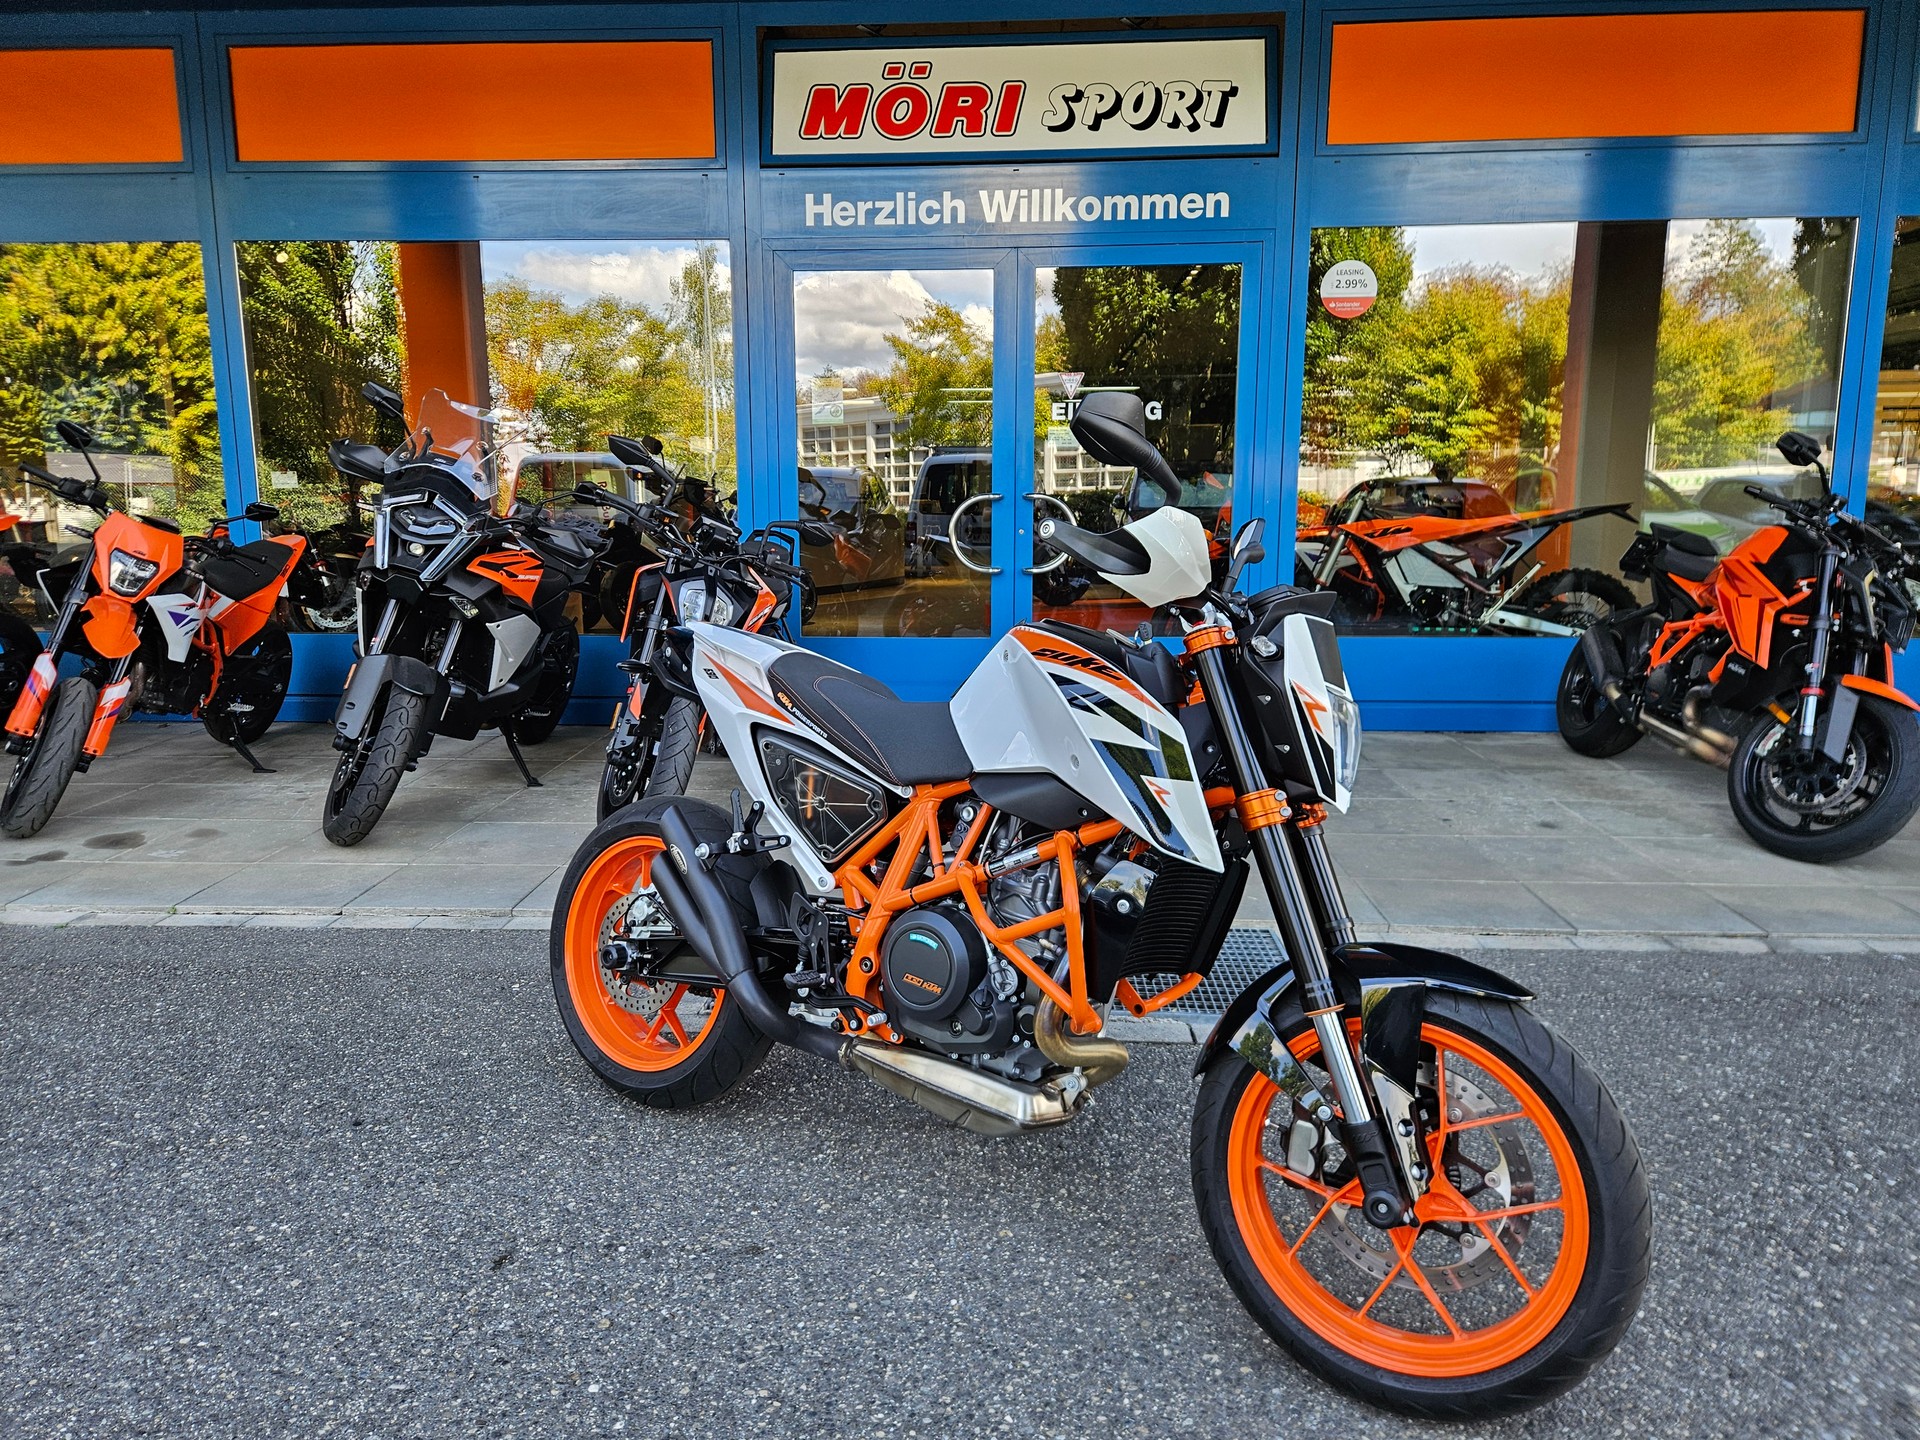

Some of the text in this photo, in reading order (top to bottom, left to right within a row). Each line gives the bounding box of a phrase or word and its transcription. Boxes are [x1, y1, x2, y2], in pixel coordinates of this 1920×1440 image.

[800, 61, 1239, 139] MÖRI SPORT
[805, 187, 1229, 227] Herzlich Willkommen
[1335, 279, 1368, 289] 2.99%
[1336, 268, 1364, 276] LEASING
[1031, 647, 1123, 681] DUKE
[776, 691, 794, 711] KTM
